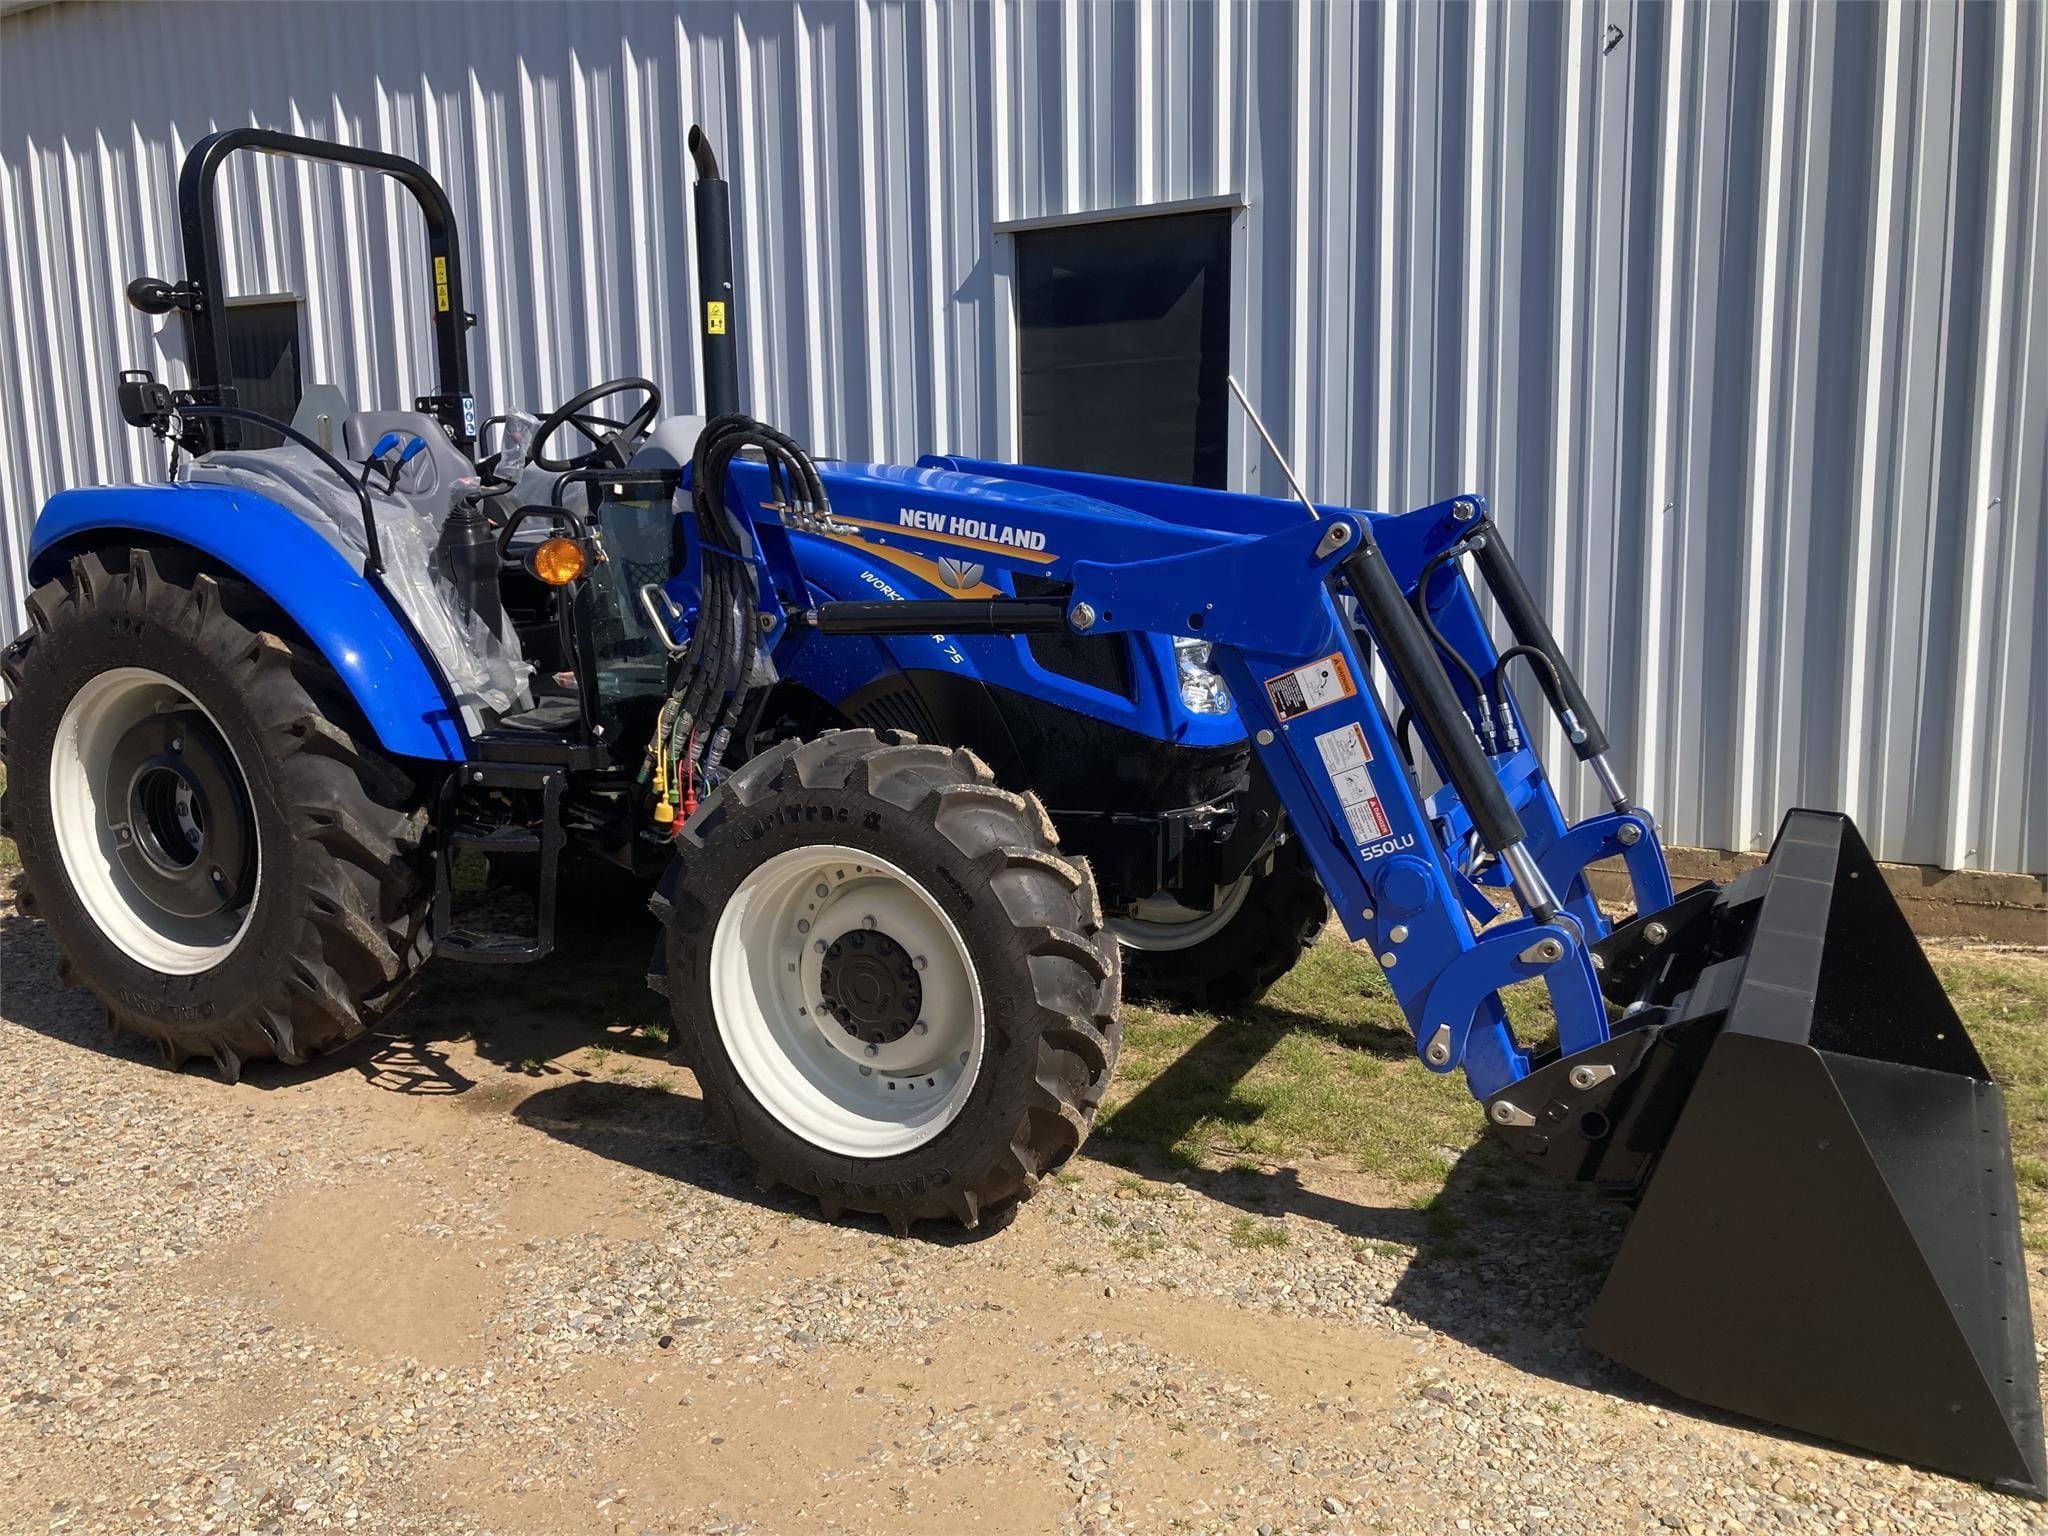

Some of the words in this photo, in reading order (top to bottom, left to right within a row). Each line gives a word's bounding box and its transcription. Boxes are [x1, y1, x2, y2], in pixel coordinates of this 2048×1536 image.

[899, 508, 947, 532] NEW
[949, 516, 1046, 551] HOLLAND
[943, 645, 964, 664] 75
[1336, 664, 1352, 693] WARNING
[1373, 807, 1388, 834] DANGER
[1360, 833, 1415, 862] 550LU
